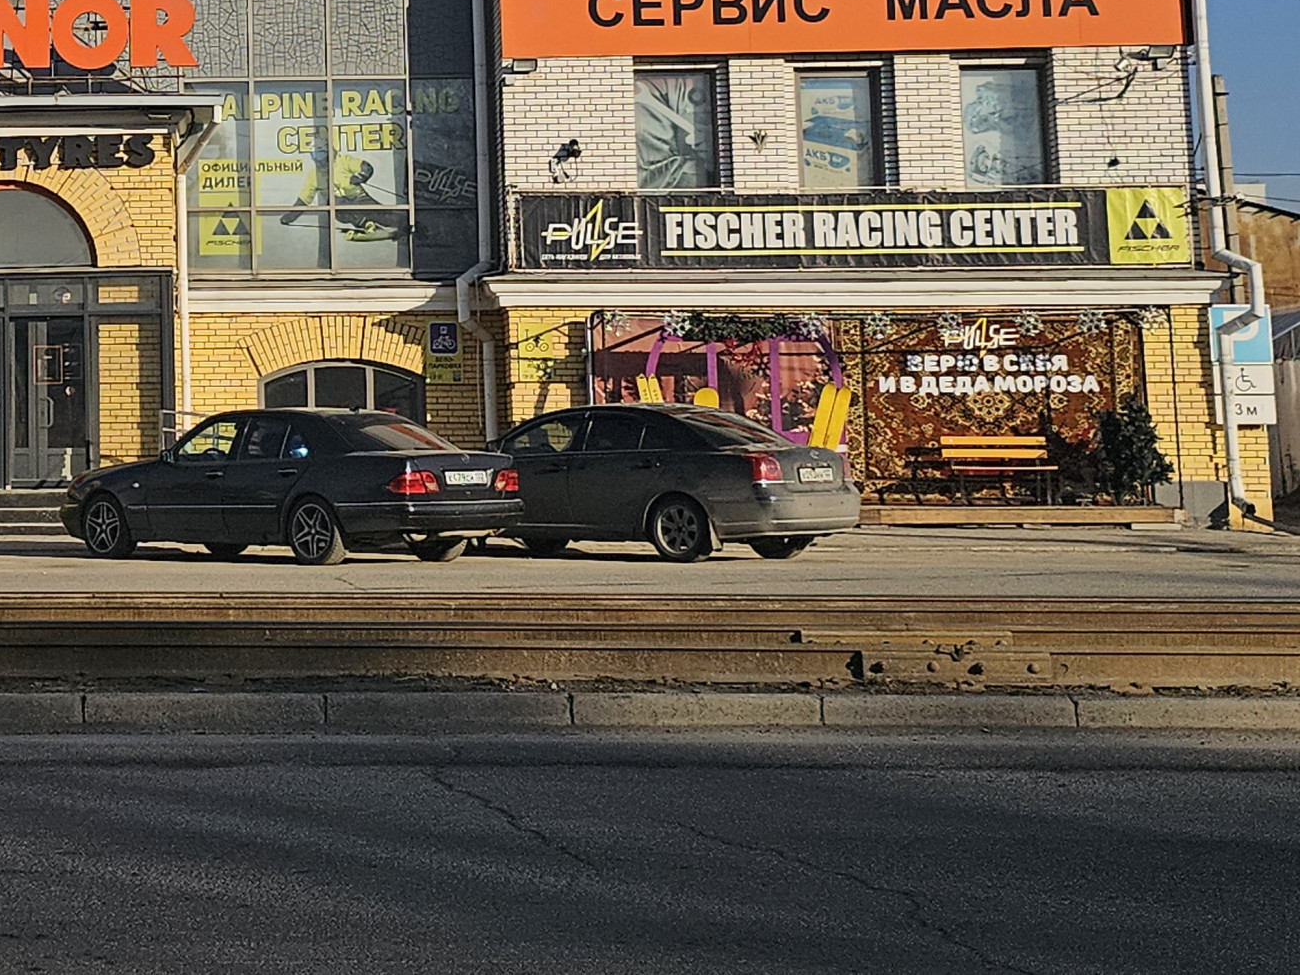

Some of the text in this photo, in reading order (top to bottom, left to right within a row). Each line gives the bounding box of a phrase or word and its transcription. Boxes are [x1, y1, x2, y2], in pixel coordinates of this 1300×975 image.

[222, 87, 460, 121] ALPINE RACNG
[201, 159, 304, 174] ОФИЦИЛЬНЫЙ
[542, 215, 643, 252] PULSE
[665, 208, 1079, 249] FISCHER RACING CENTER
[1117, 244, 1180, 252] FISCHER
[942, 323, 1021, 350] PULSE
[983, 354, 1001, 372] В
[878, 374, 1101, 396] И В ДЕДА МОРОЗА
[1234, 403, 1244, 416] 3
